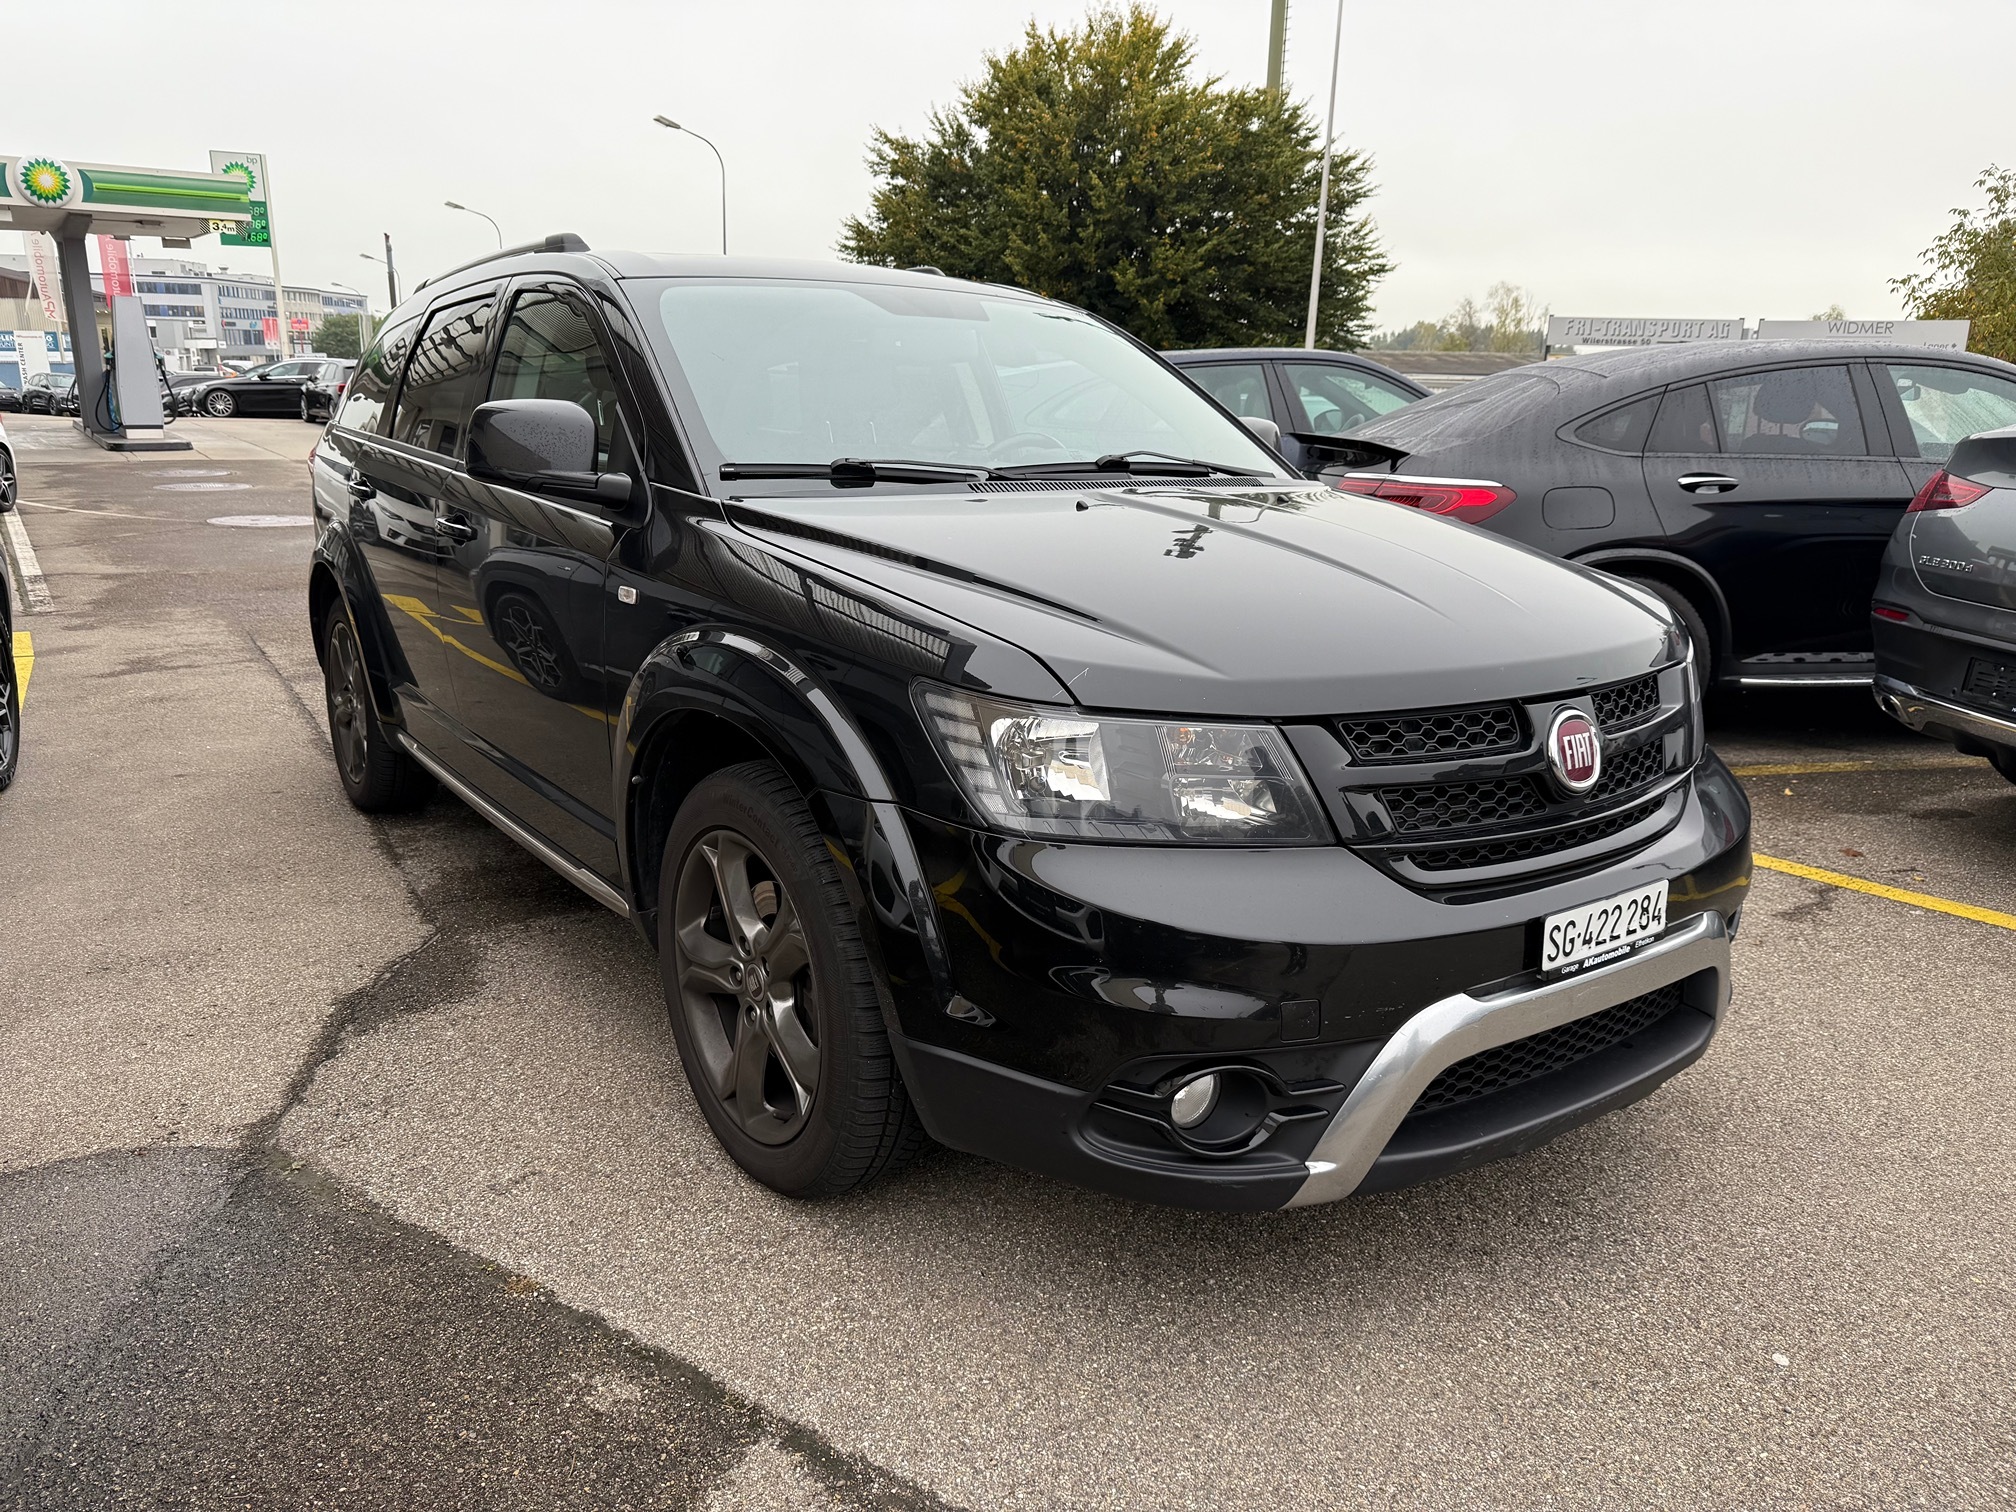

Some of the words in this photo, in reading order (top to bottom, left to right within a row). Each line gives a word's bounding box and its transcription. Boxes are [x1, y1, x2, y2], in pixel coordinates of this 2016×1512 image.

[246, 156, 258, 165] bp
[1564, 319, 1705, 339] FRI-TRANSPORT
[1707, 320, 1731, 339] AG
[1827, 321, 1895, 335] WIDMER
[1582, 337, 1638, 345] Wilerstrasse
[17, 342, 27, 366] CENTER
[1562, 731, 1593, 771] FIAT
[1561, 963, 1579, 974] Garage
